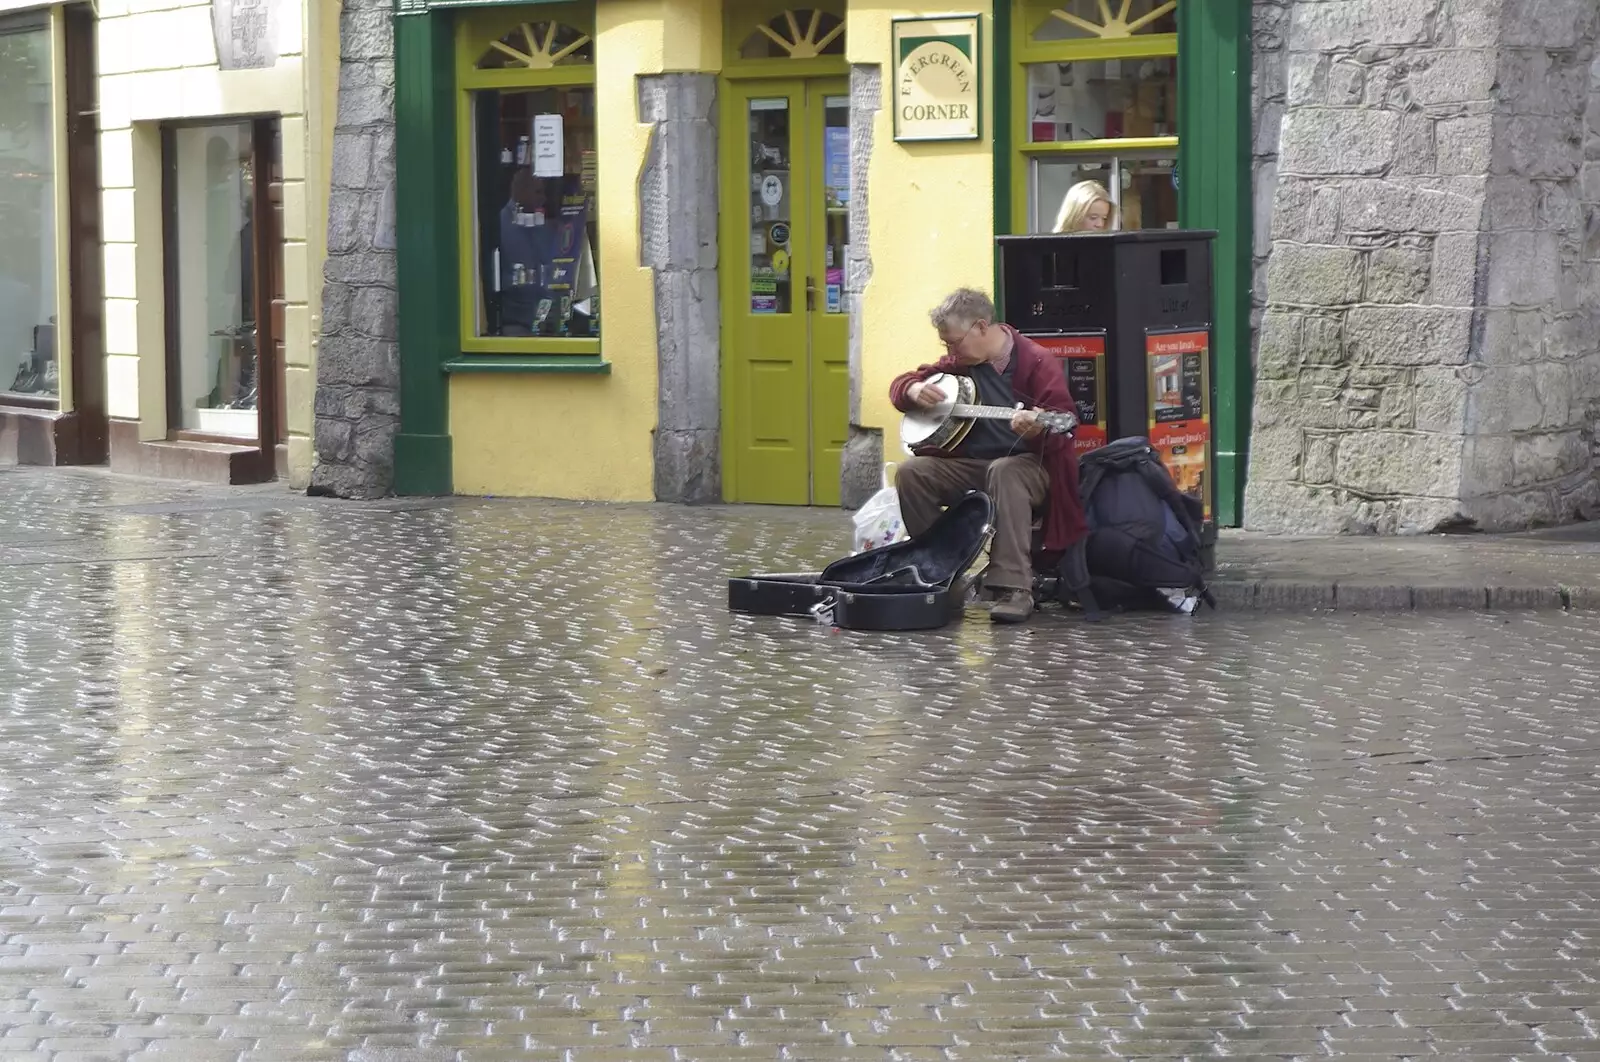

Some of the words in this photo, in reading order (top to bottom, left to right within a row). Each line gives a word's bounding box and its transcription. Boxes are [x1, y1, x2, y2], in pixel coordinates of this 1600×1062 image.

[902, 52, 971, 96] EVERGREEN
[902, 103, 970, 121] CORNER
[1083, 412, 1095, 421] 7/7
